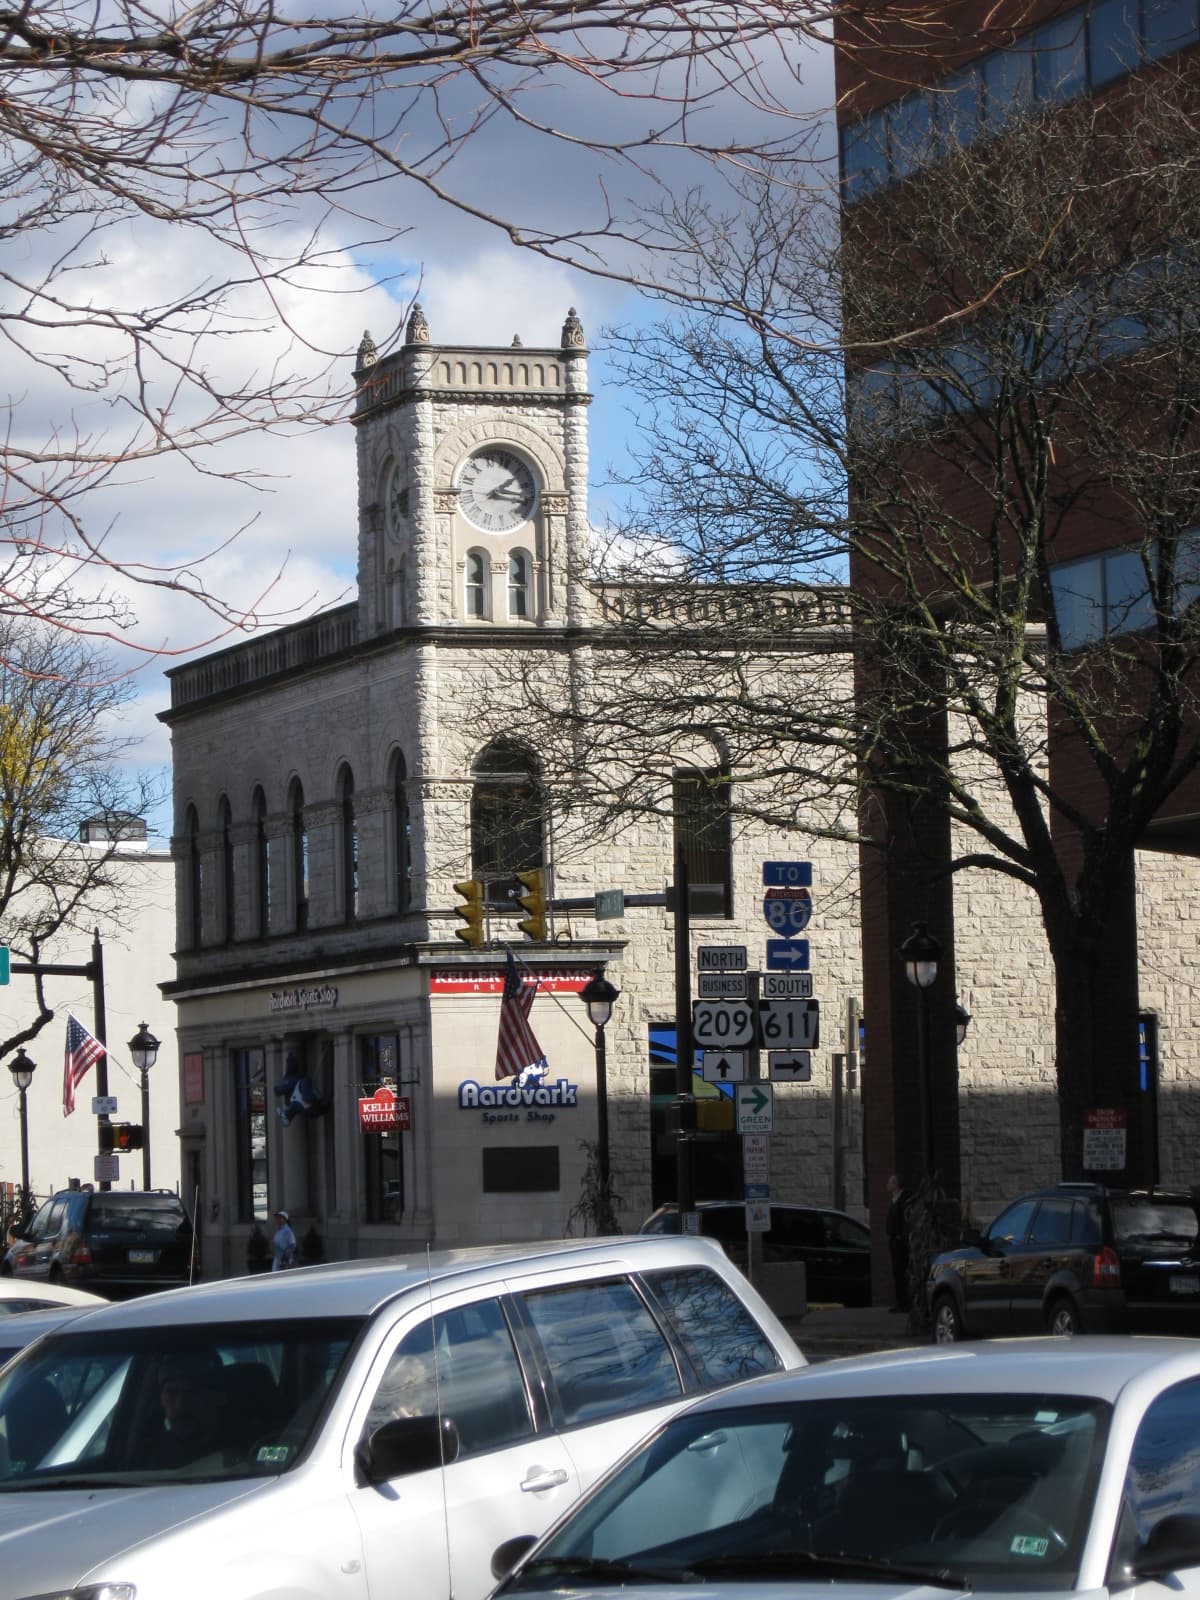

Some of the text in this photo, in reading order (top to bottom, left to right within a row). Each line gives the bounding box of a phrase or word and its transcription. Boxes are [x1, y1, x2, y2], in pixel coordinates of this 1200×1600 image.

[776, 867, 799, 881] TO
[768, 901, 808, 928] 80
[701, 951, 743, 967] NORTH
[435, 970, 591, 984] KELLER ILLIAMS
[702, 979, 743, 992] BUSINESS
[768, 978, 809, 994] SOUTH
[698, 1010, 748, 1037] 209
[764, 1012, 809, 1039] 611
[460, 1080, 577, 1107] Aardvark
[362, 1101, 407, 1113] KELLER
[361, 1112, 409, 1123] WILLIAMS
[482, 1111, 556, 1126] Sports Shop
[740, 1116, 771, 1124] GREEN
